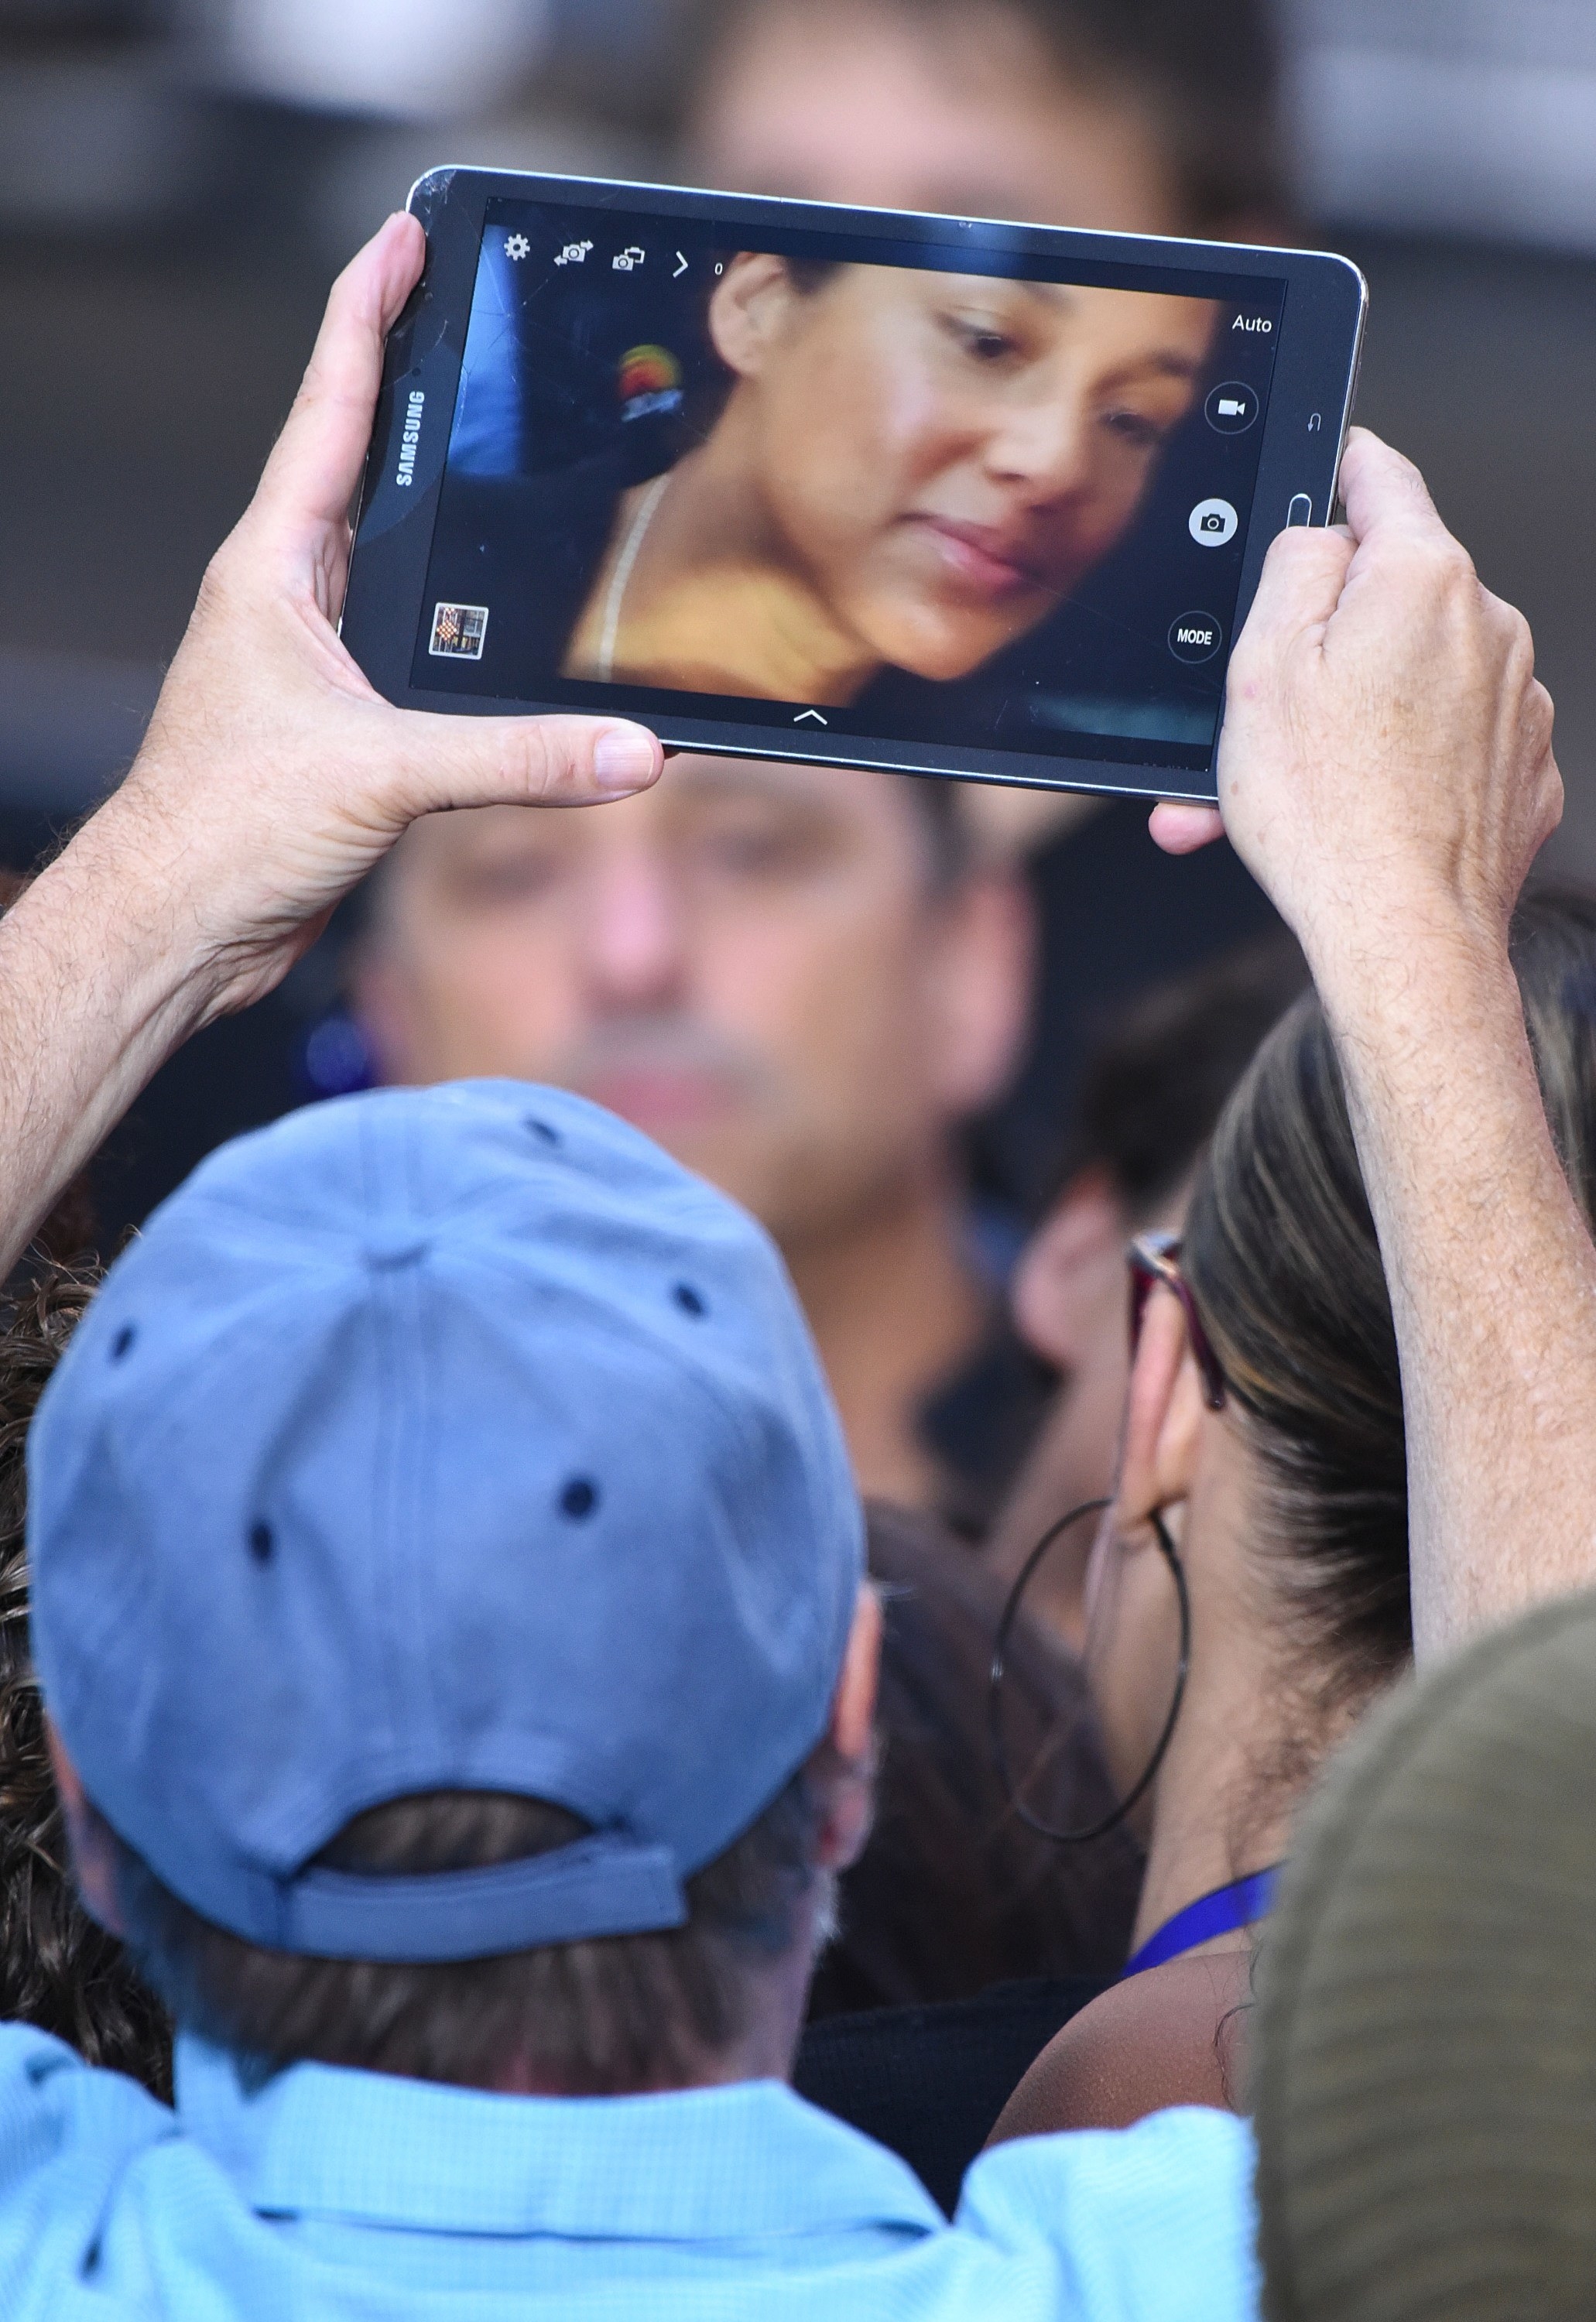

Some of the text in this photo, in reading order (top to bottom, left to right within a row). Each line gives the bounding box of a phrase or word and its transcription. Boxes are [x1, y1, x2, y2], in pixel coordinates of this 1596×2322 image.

[1231, 314, 1272, 333] Auto
[396, 391, 425, 486] SAMSUNG
[1177, 628, 1213, 645] MODE
